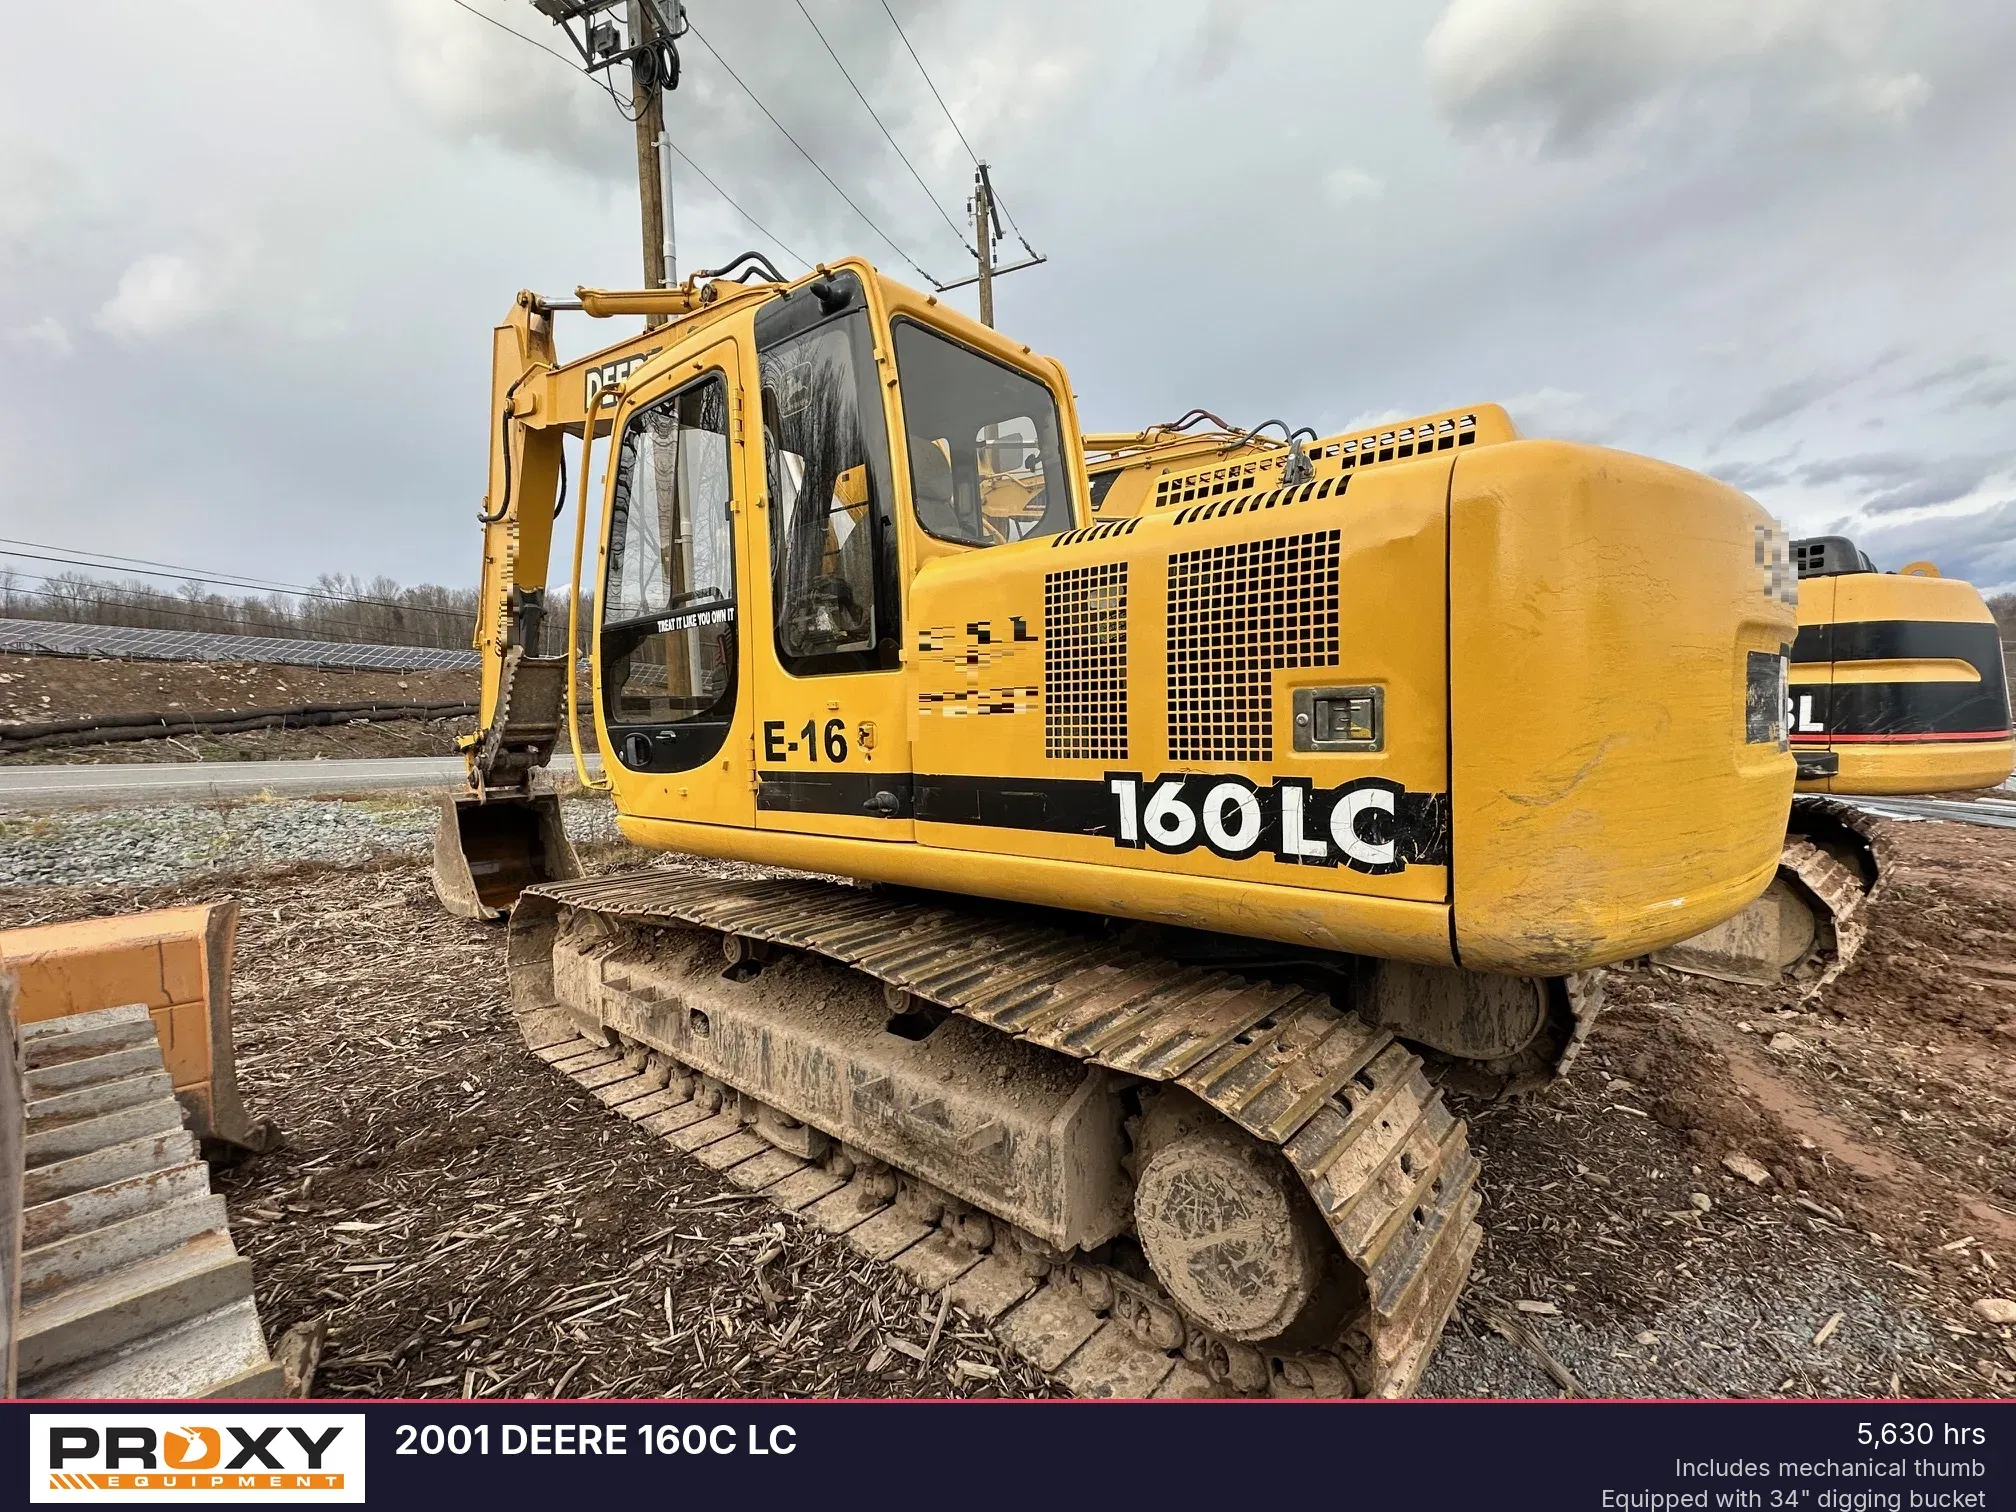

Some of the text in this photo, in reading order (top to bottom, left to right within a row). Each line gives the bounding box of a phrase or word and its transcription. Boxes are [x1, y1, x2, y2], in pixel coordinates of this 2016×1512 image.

[657, 607, 735, 633] TREAT IT LIKE YOU OWN IT
[763, 718, 849, 763] E-16
[1111, 780, 1396, 864] 160 LC
